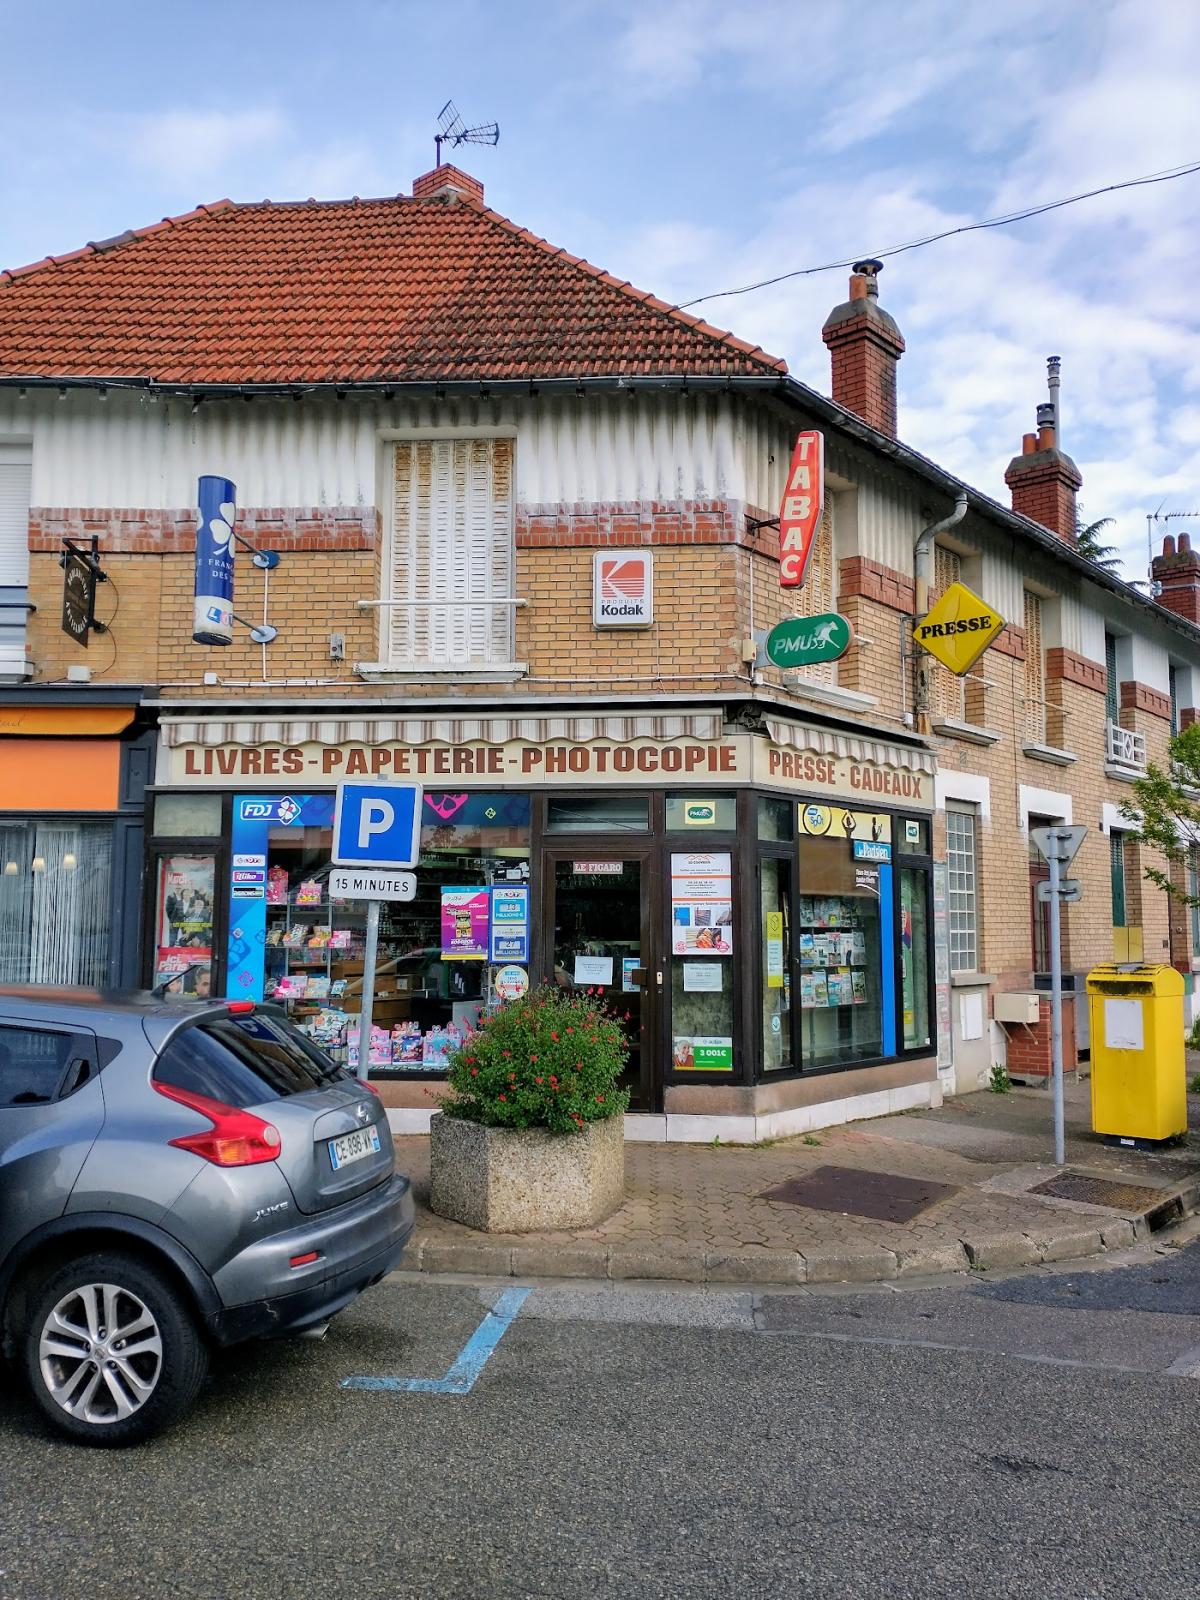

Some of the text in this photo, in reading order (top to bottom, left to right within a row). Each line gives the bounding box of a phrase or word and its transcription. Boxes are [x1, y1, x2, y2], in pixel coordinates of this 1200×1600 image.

[781, 436, 815, 579] TABAC
[601, 604, 644, 616] Kodak
[920, 615, 992, 639] PRESSE
[773, 634, 814, 655] PMU
[769, 749, 836, 785] PRESSE
[850, 765, 922, 799] CADEAUX
[244, 804, 273, 817] FDJ
[358, 797, 395, 848] P
[863, 842, 889, 859] Parisien
[574, 863, 622, 872] LE FIGARO
[335, 878, 409, 892] 15 MINUTES
[506, 940, 515, 948] 27
[252, 1201, 289, 1222] JUKE
